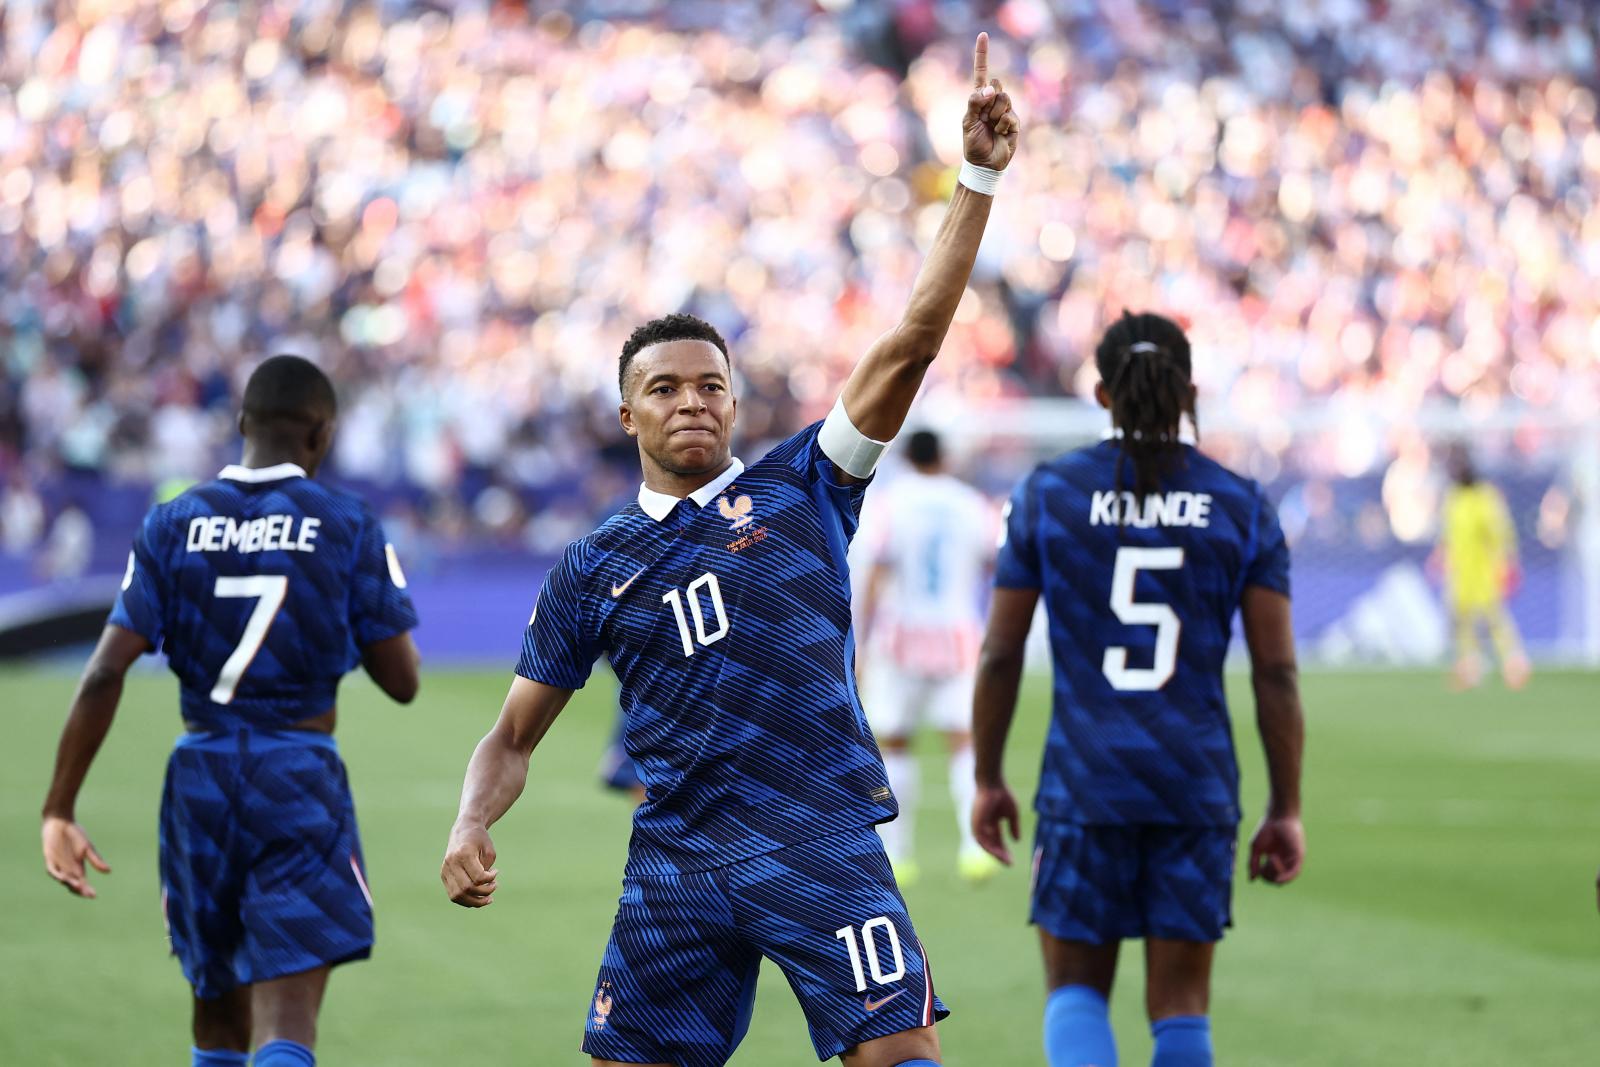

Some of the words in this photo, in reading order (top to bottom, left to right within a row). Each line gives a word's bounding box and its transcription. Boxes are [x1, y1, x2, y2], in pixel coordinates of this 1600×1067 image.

[186, 514, 322, 554] DEMBELE
[1089, 490, 1213, 529] KOUNDE
[210, 575, 288, 705] 7
[662, 572, 729, 657] 10
[1102, 546, 1184, 692] 5
[835, 916, 906, 992] 10
